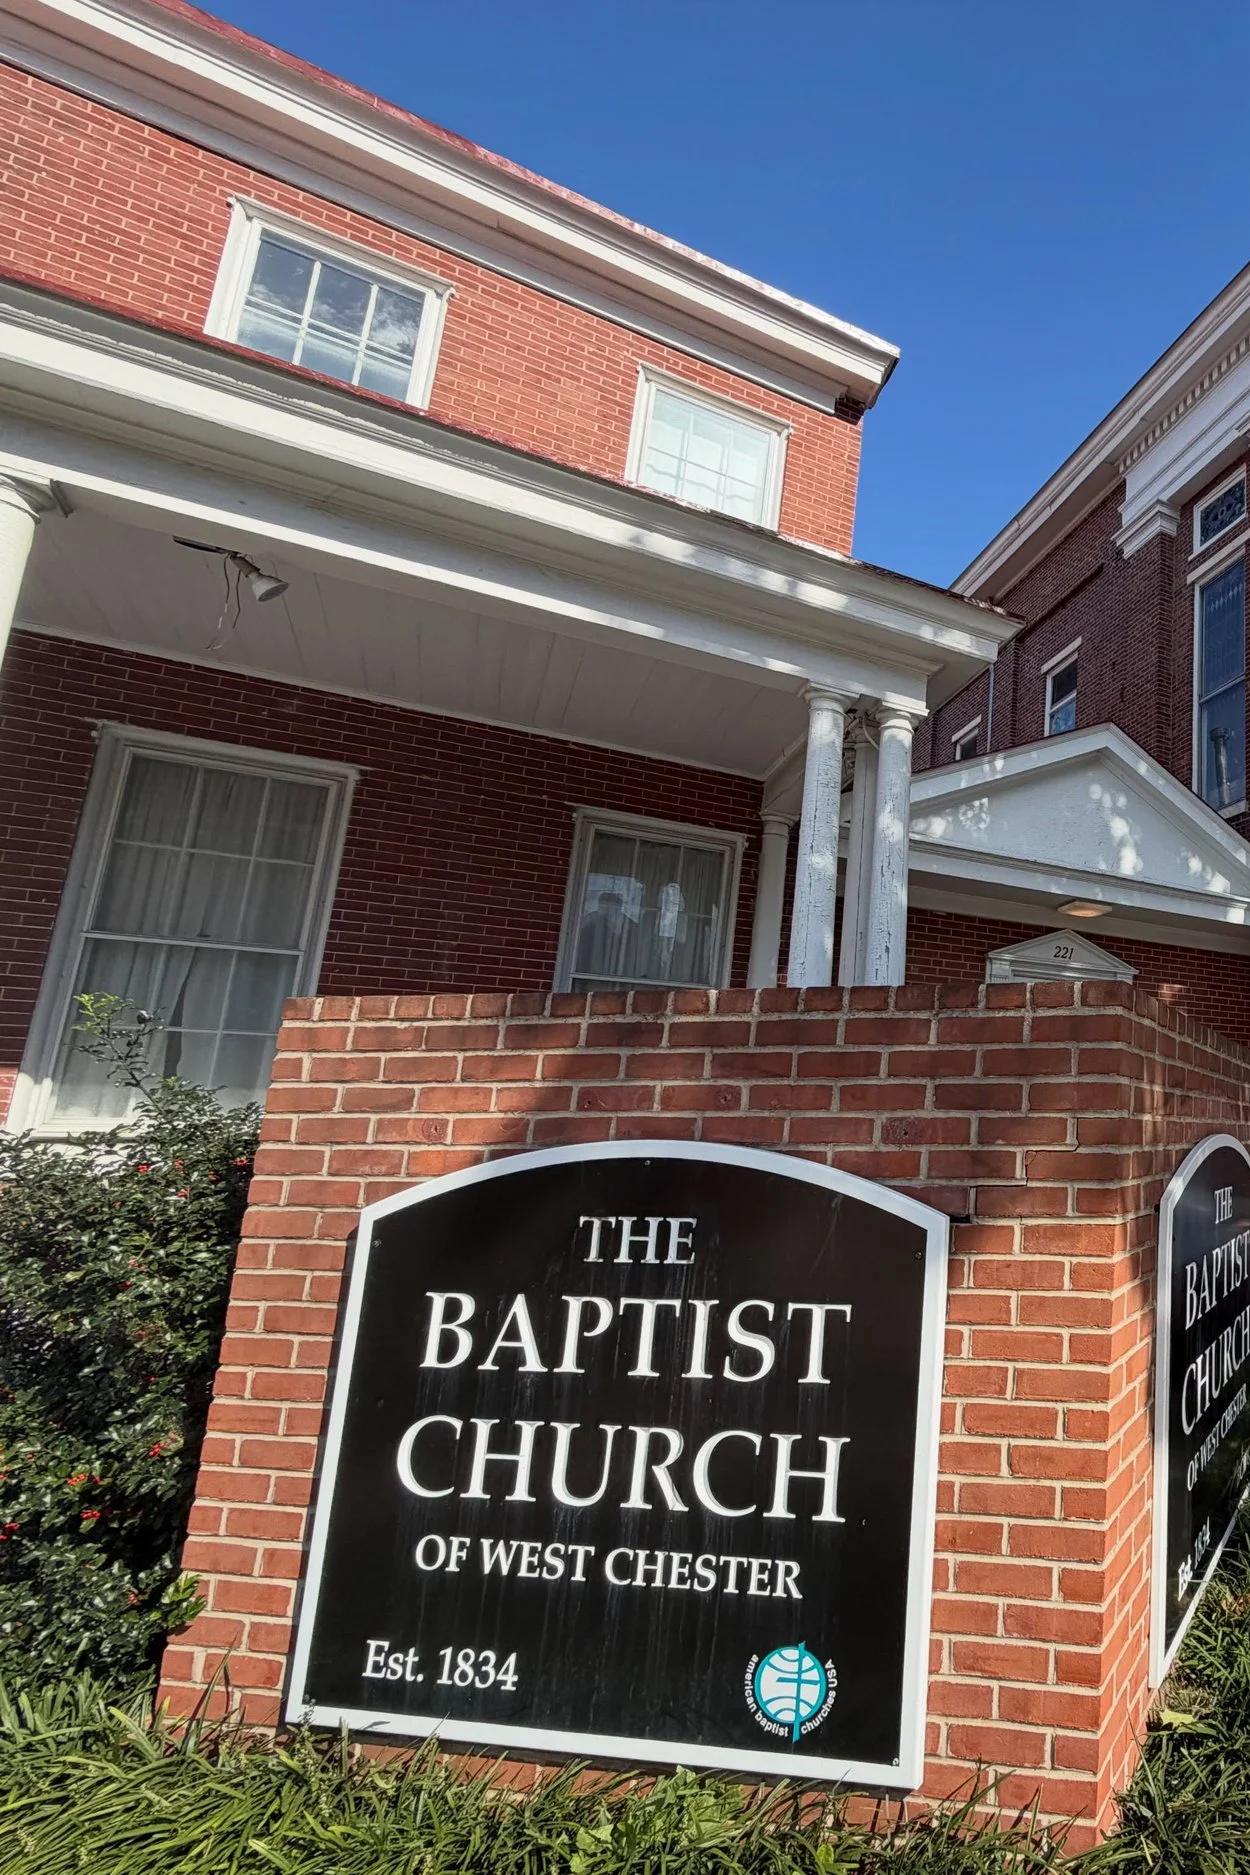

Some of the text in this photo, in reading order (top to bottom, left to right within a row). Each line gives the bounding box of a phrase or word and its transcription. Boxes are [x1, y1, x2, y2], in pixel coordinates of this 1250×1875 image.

[1053, 945, 1074, 960] 221
[579, 1215, 698, 1265] THE
[1214, 1186, 1233, 1224] THE
[1185, 1230, 1250, 1330] BAPTIST
[419, 1291, 852, 1384] BAPTIST
[1181, 1304, 1250, 1436] CHURCH
[396, 1414, 851, 1523] CHURCH
[1187, 1451, 1199, 1491] OF
[1200, 1420, 1220, 1472] WEST
[1220, 1383, 1247, 1438] CHESTER
[415, 1534, 803, 1599] OF WEST CHESTER
[362, 1640, 519, 1692] Est. 1834
[744, 1654, 838, 1737] american baptist churches USA
